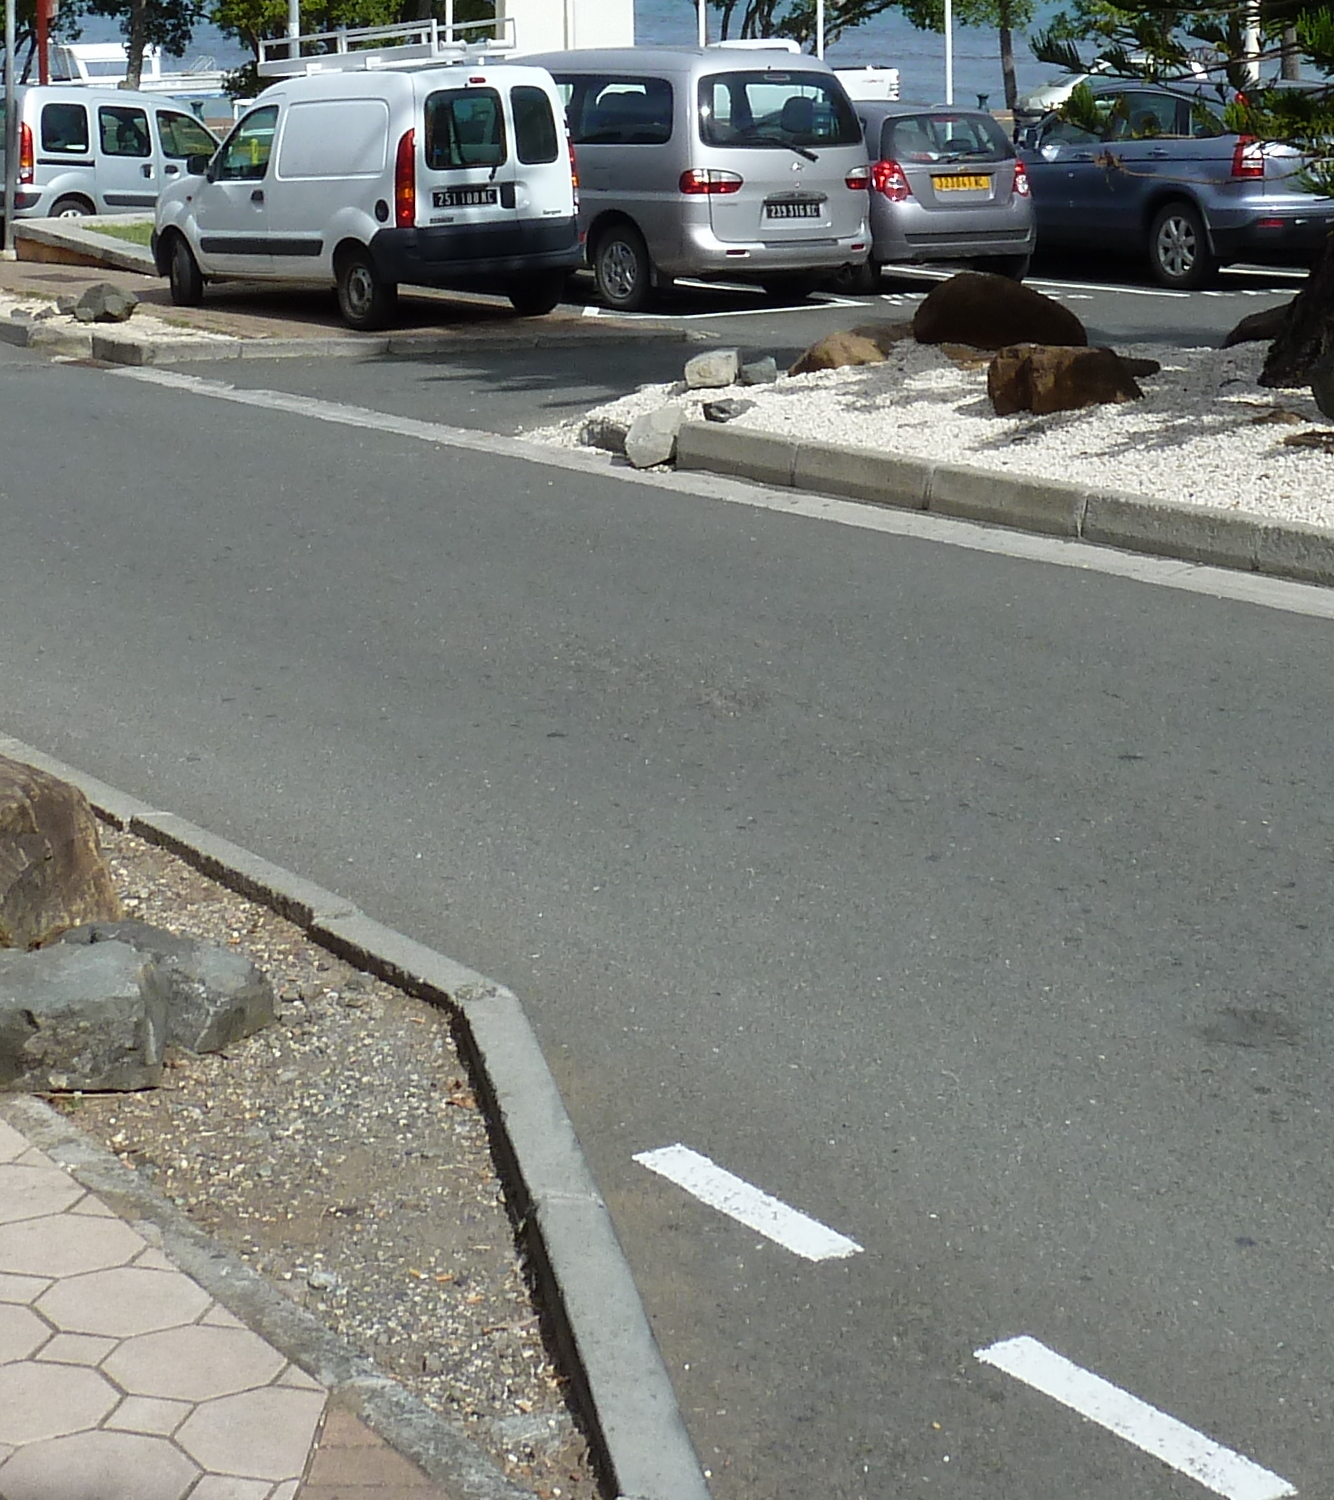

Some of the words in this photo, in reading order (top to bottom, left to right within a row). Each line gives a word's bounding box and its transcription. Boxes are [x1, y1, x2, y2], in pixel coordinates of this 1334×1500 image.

[437, 193, 457, 206] 251
[461, 191, 480, 204] 100
[481, 190, 494, 203] NC
